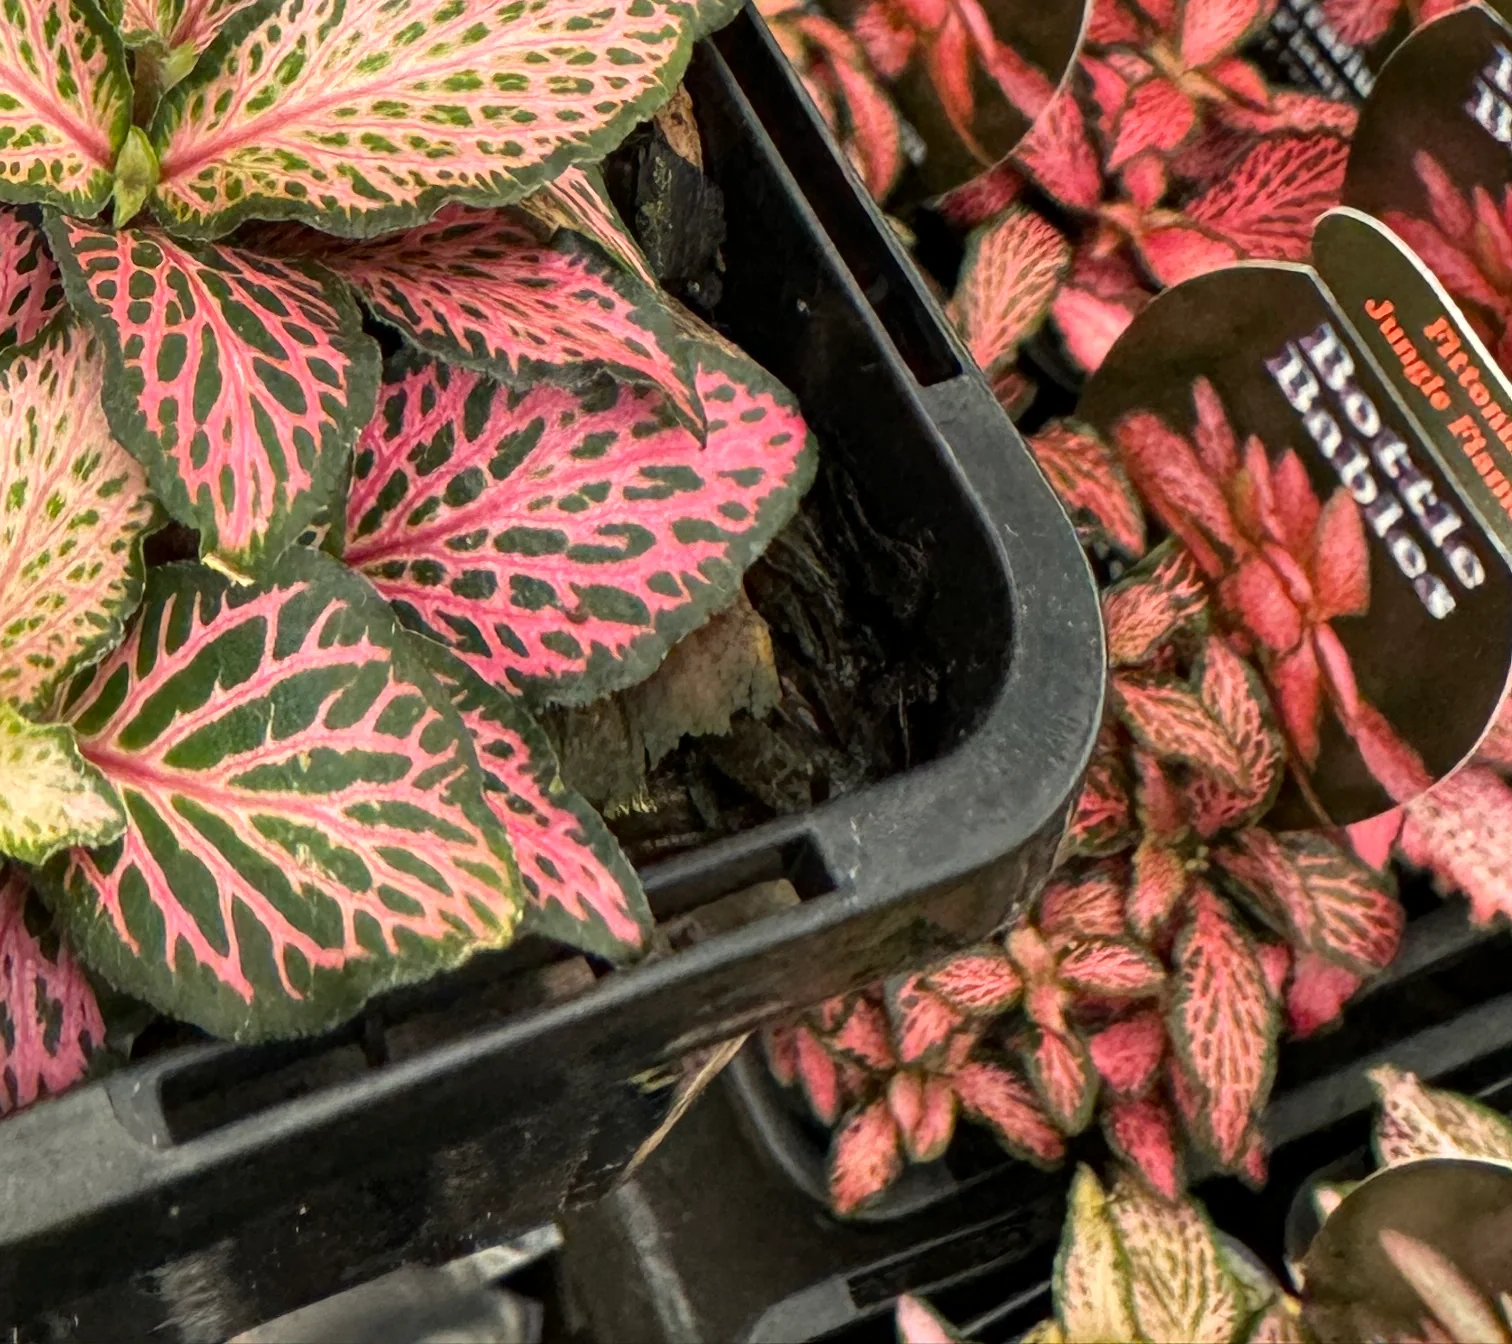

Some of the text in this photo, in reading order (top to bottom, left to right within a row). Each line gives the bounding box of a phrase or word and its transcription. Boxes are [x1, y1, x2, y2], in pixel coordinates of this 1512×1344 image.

[1265, 341, 1456, 619] Babies
[1299, 322, 1486, 590] Bottle
[1365, 299, 1512, 519] Jungle Flam
